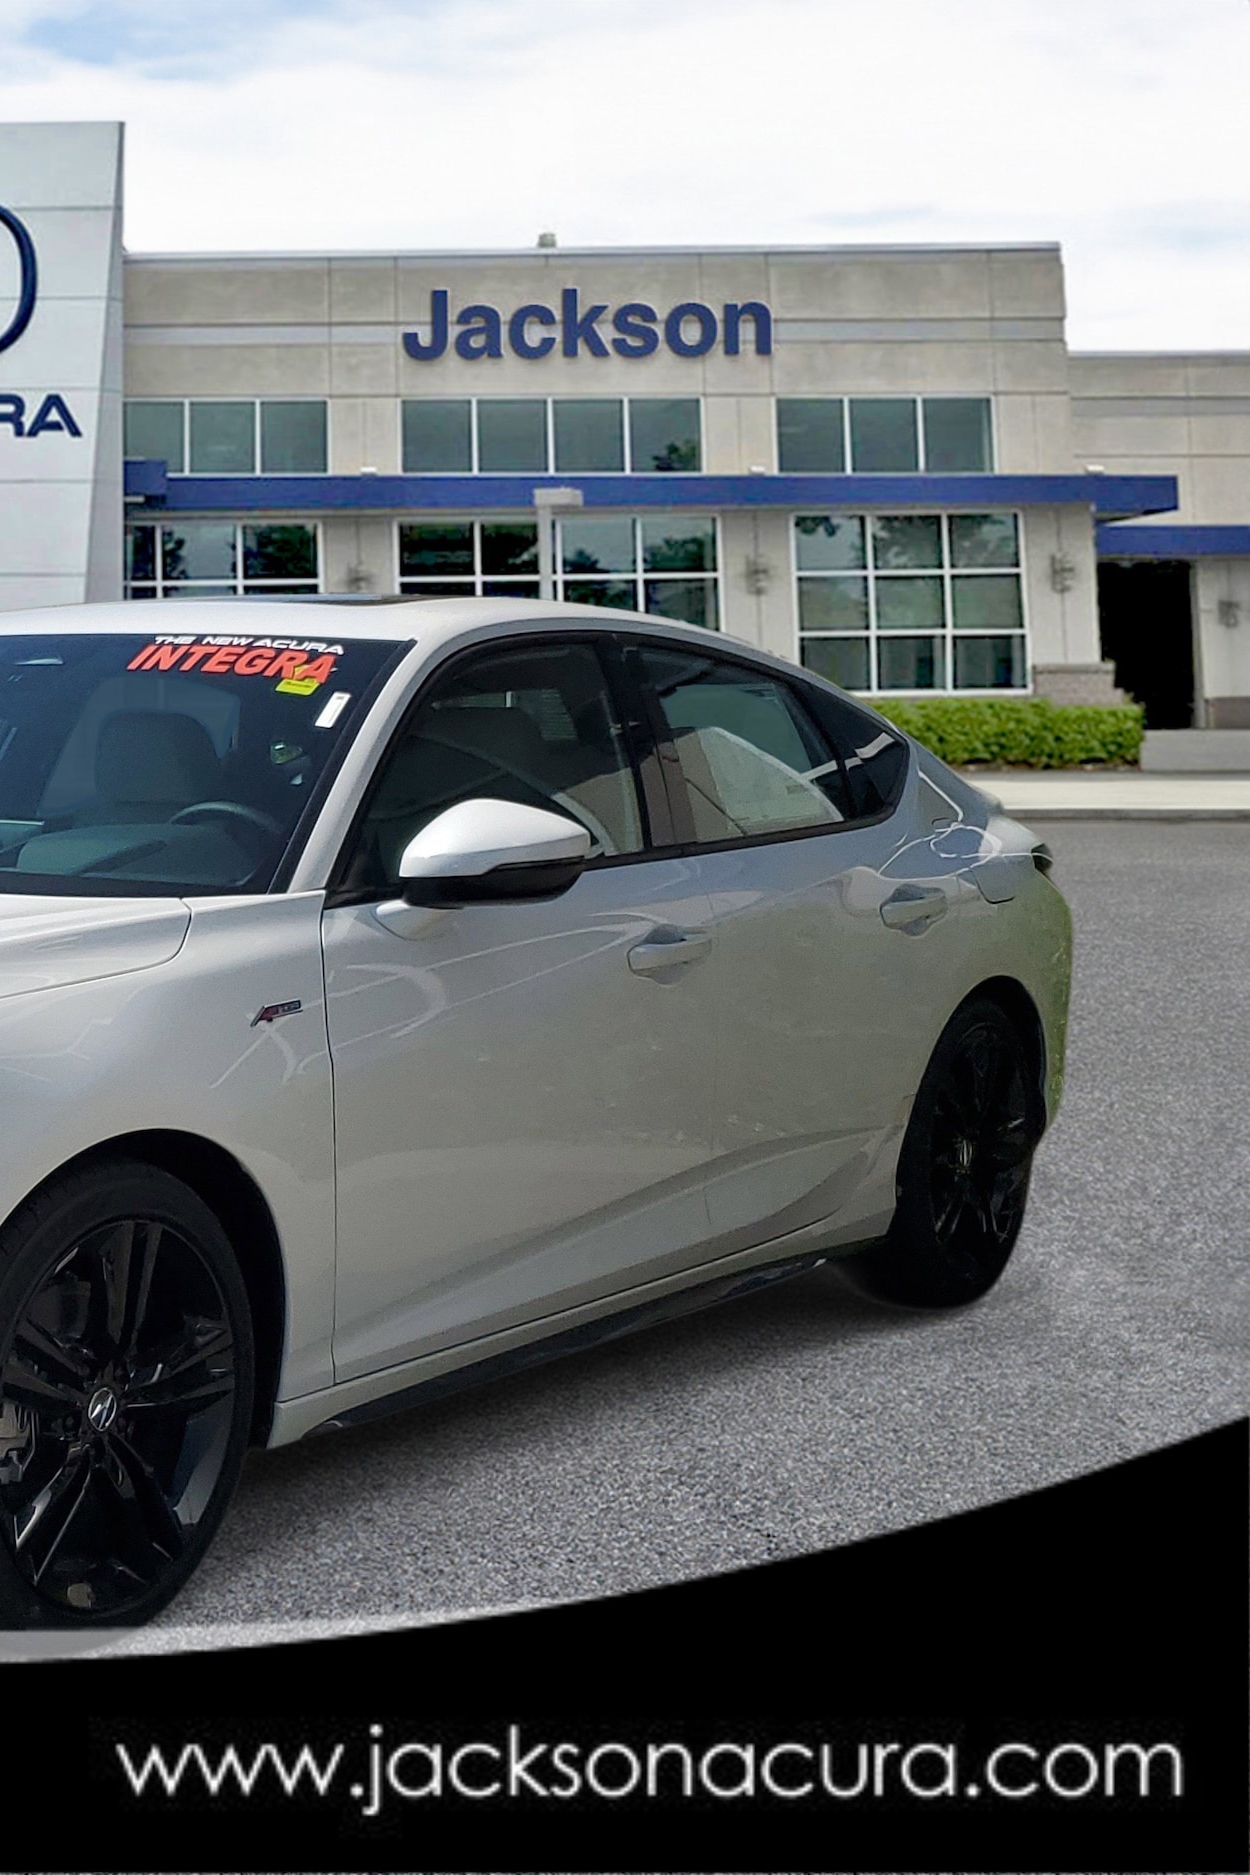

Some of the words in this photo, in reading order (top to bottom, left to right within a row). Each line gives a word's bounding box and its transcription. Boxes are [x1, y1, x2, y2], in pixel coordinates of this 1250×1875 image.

[403, 288, 773, 360] Jackson
[126, 643, 338, 685] INTEGRA
[154, 635, 198, 646] THE
[201, 636, 255, 647] NEW
[252, 638, 345, 656] ACURA
